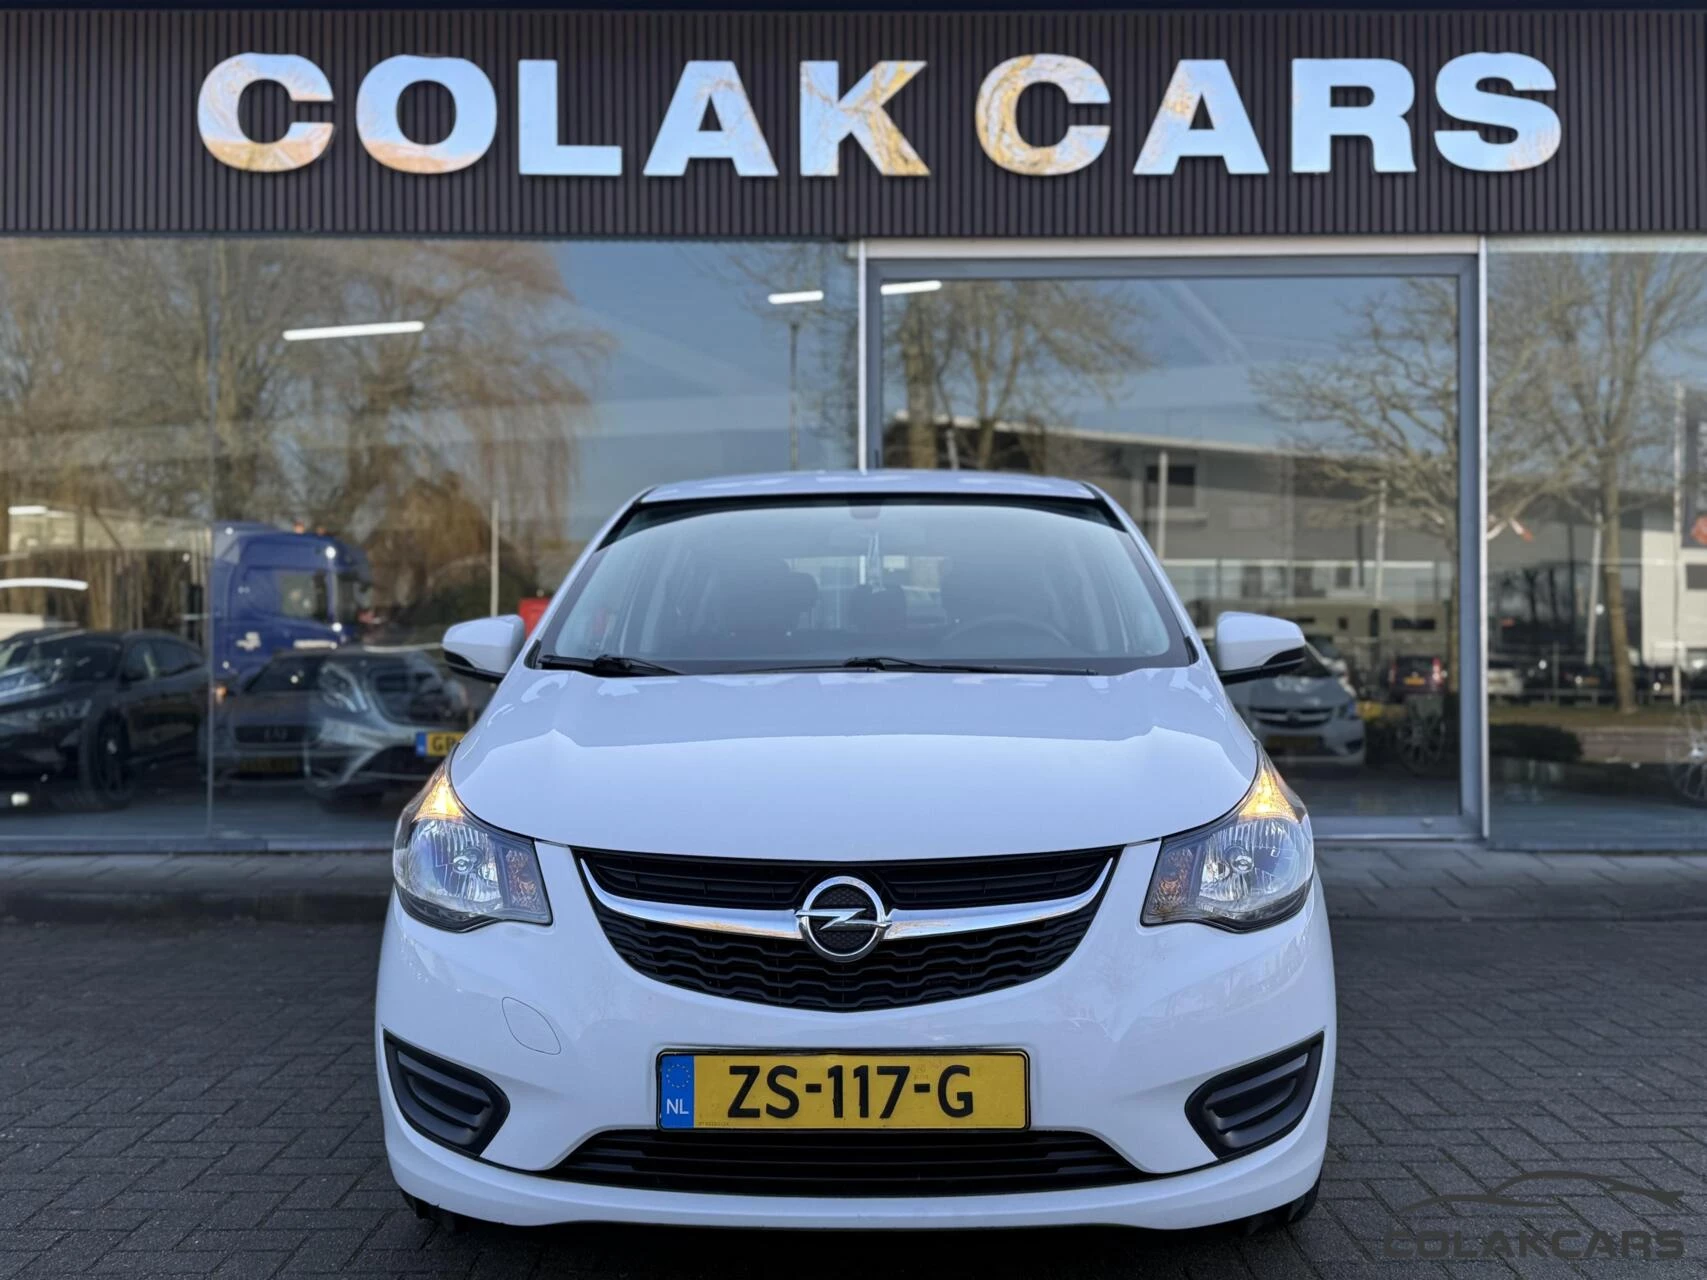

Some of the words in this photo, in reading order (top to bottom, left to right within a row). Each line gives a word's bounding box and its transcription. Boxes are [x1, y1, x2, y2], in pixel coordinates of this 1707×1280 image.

[197, 52, 931, 177] COLAK
[975, 51, 1562, 176] CARS
[666, 1098, 689, 1115] NL
[727, 1064, 974, 1119] ZS-117-G
